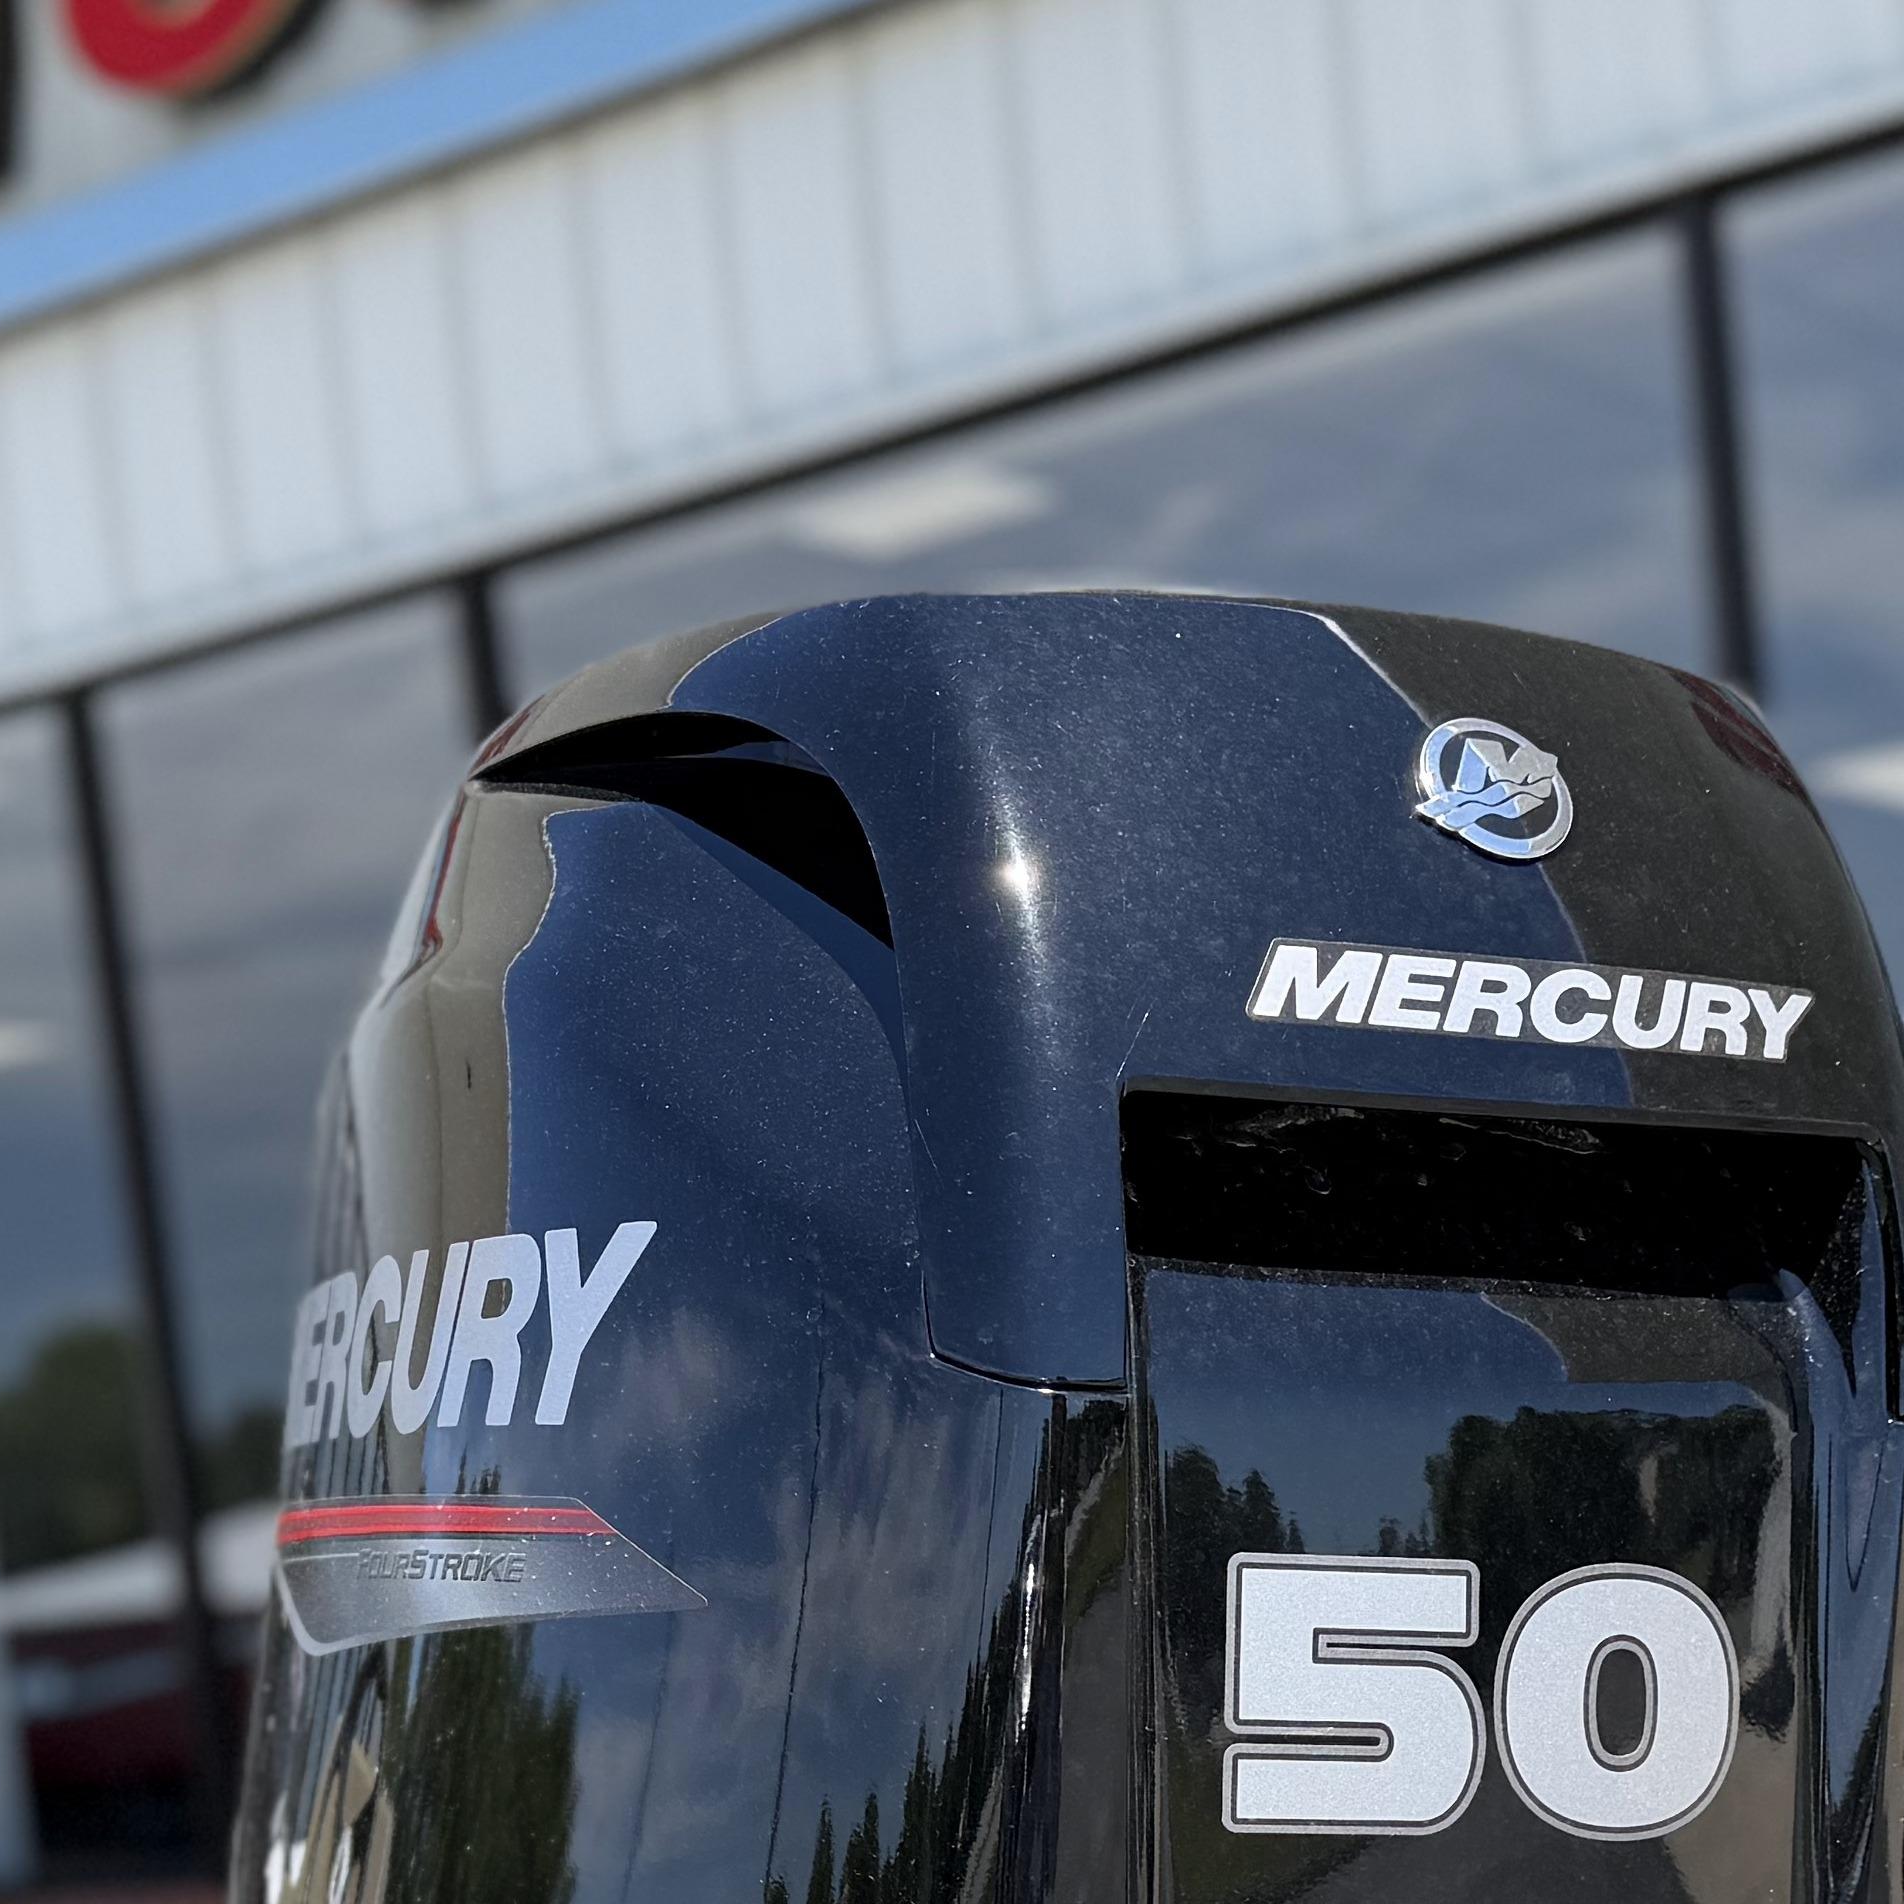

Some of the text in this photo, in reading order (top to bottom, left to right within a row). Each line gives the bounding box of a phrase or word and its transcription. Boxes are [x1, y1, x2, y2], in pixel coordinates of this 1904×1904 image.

[1252, 944, 1812, 1060] MERCURY
[282, 1220, 658, 1448] ERCURY
[1221, 1552, 1741, 1842] 50
